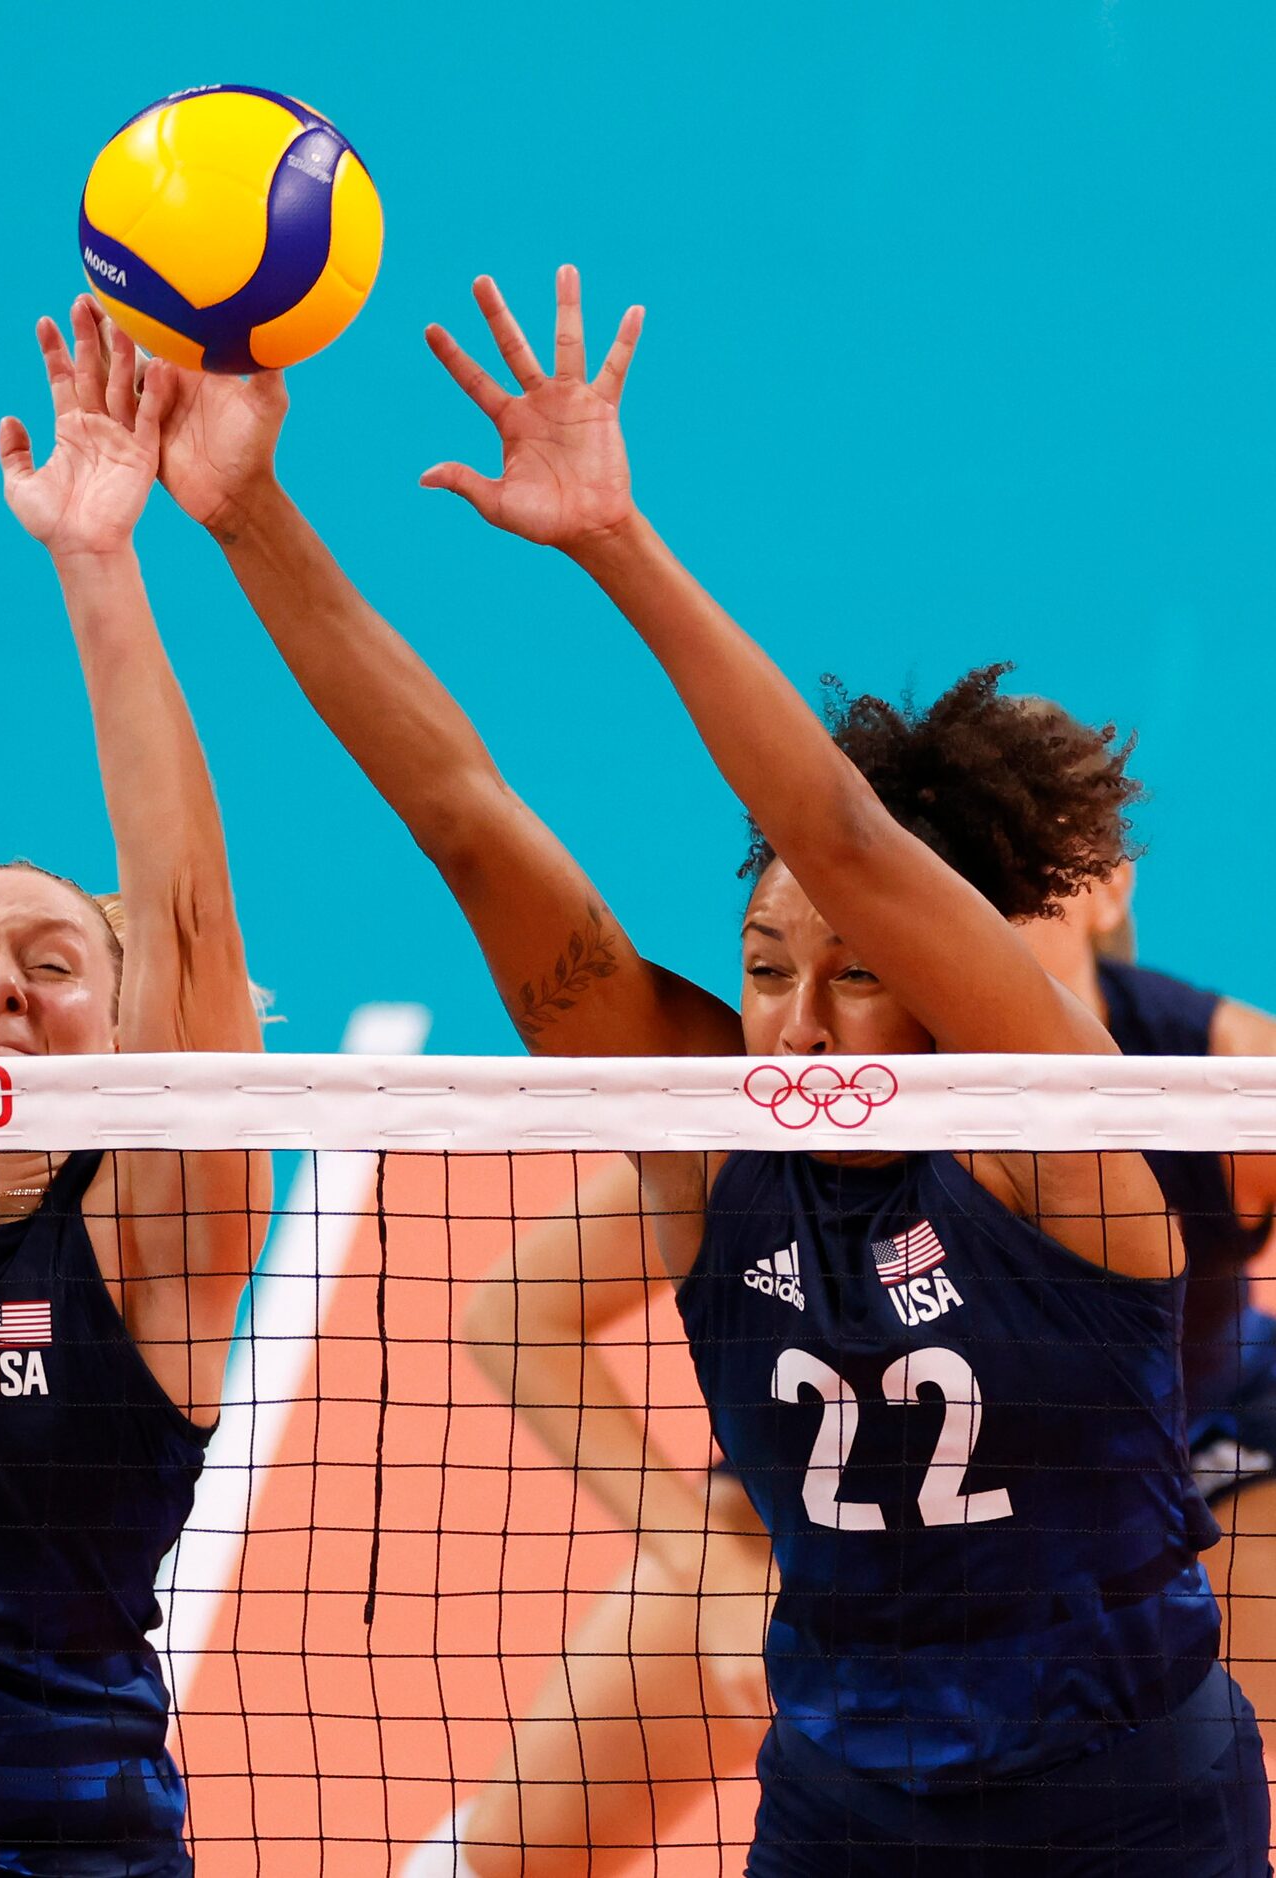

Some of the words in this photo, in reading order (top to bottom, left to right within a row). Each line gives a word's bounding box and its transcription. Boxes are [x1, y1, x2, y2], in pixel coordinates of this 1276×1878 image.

[84, 245, 127, 287] V200W
[743, 1269, 805, 1312] adidas
[888, 1268, 964, 1327] USA
[771, 1346, 1014, 1531] 22
